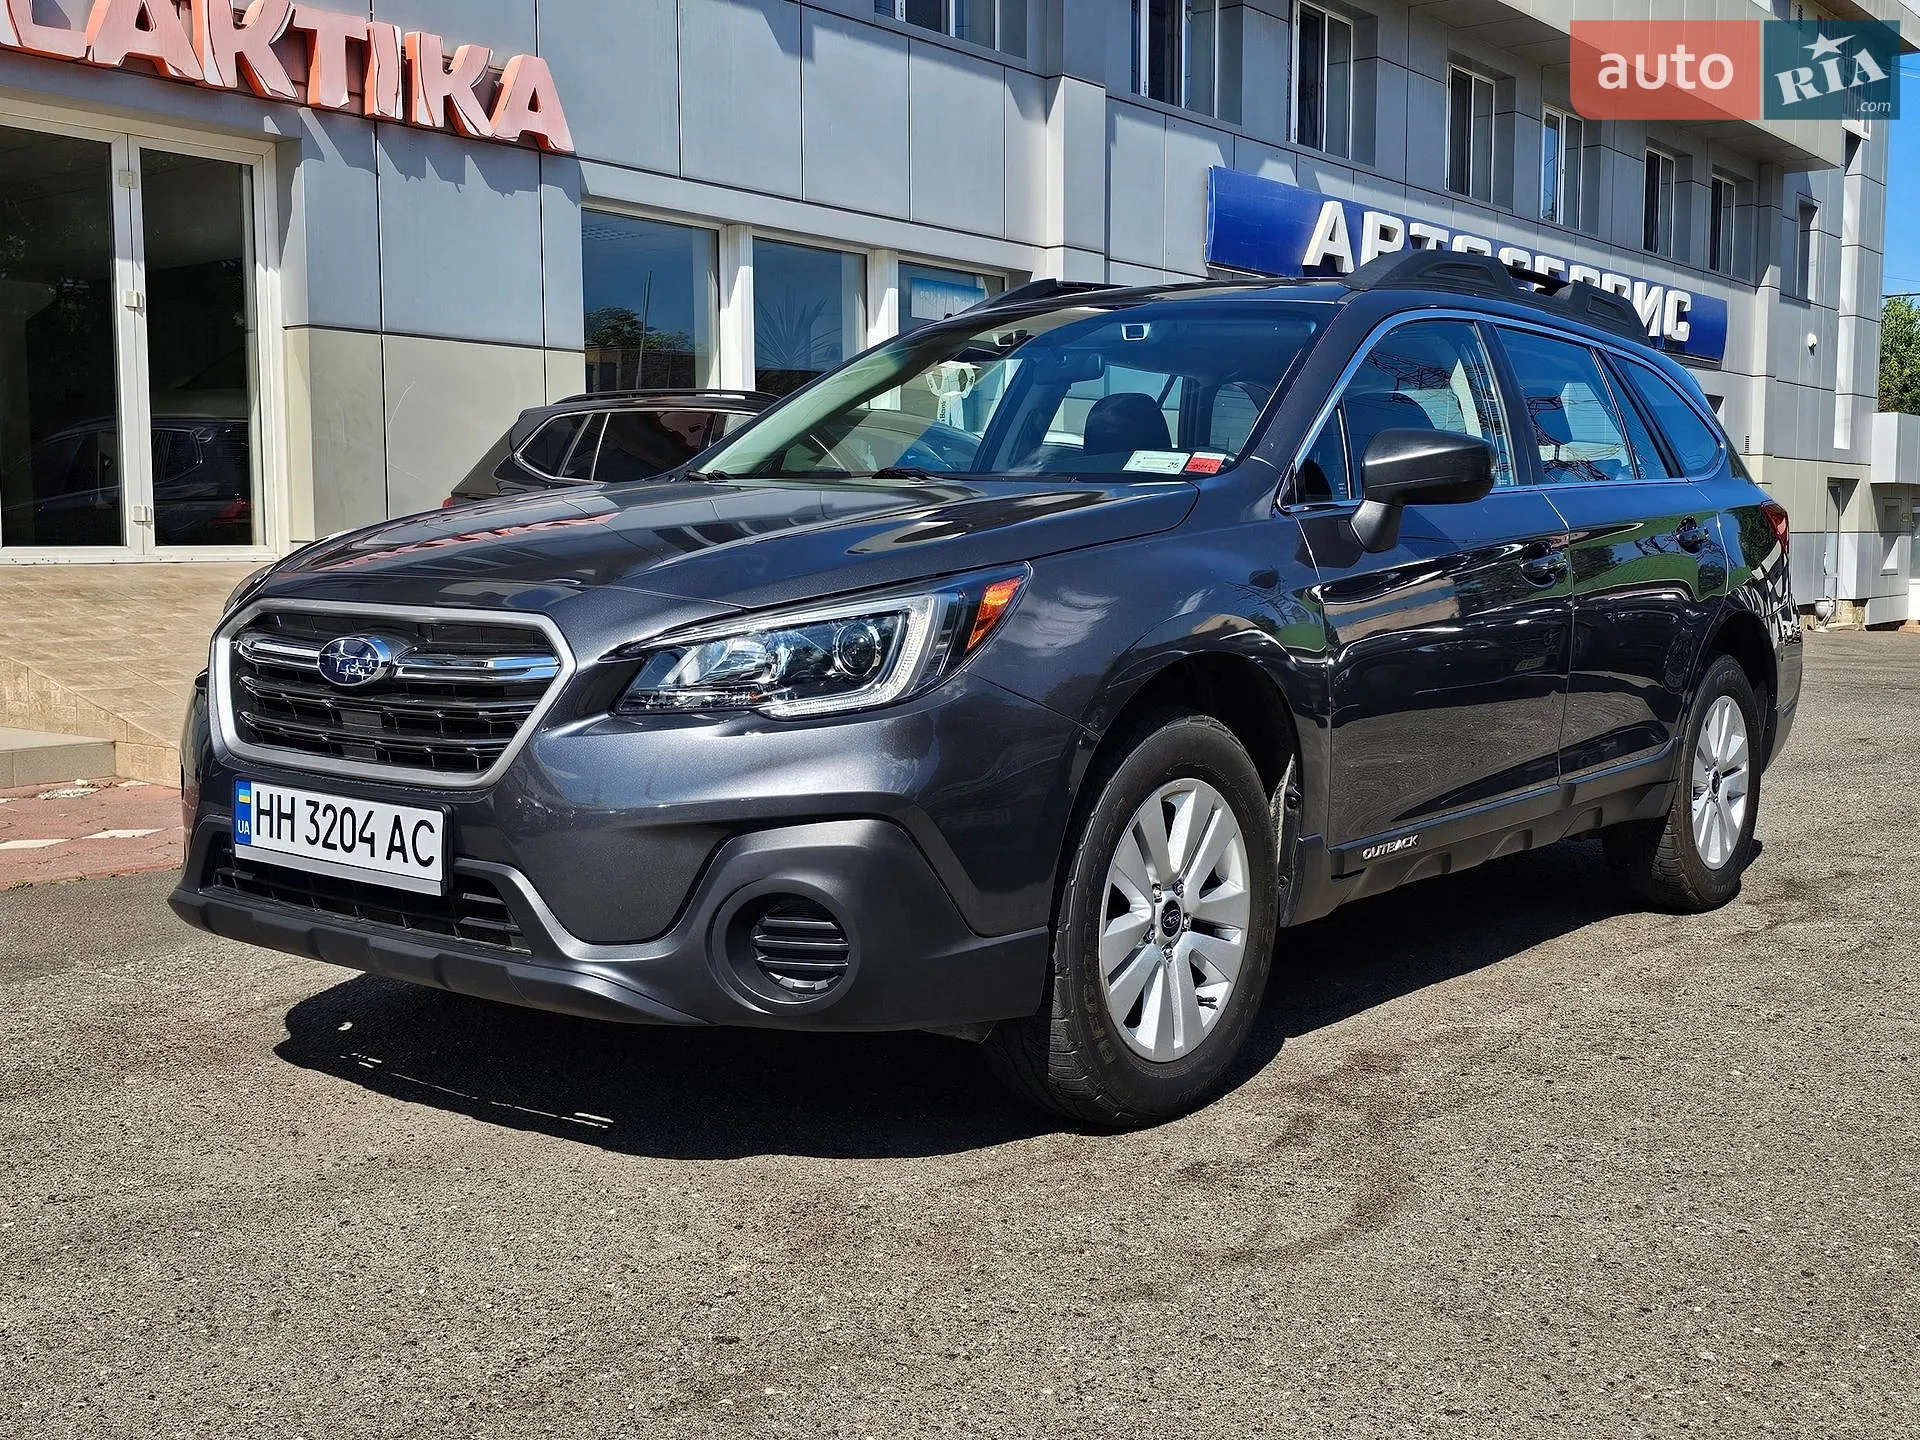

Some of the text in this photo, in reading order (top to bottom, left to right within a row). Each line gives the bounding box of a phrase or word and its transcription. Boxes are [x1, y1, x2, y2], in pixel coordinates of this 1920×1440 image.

[237, 820, 250, 835] UA
[256, 791, 436, 868] HH 3204 AC
[1362, 835, 1419, 860] OUTBACK
